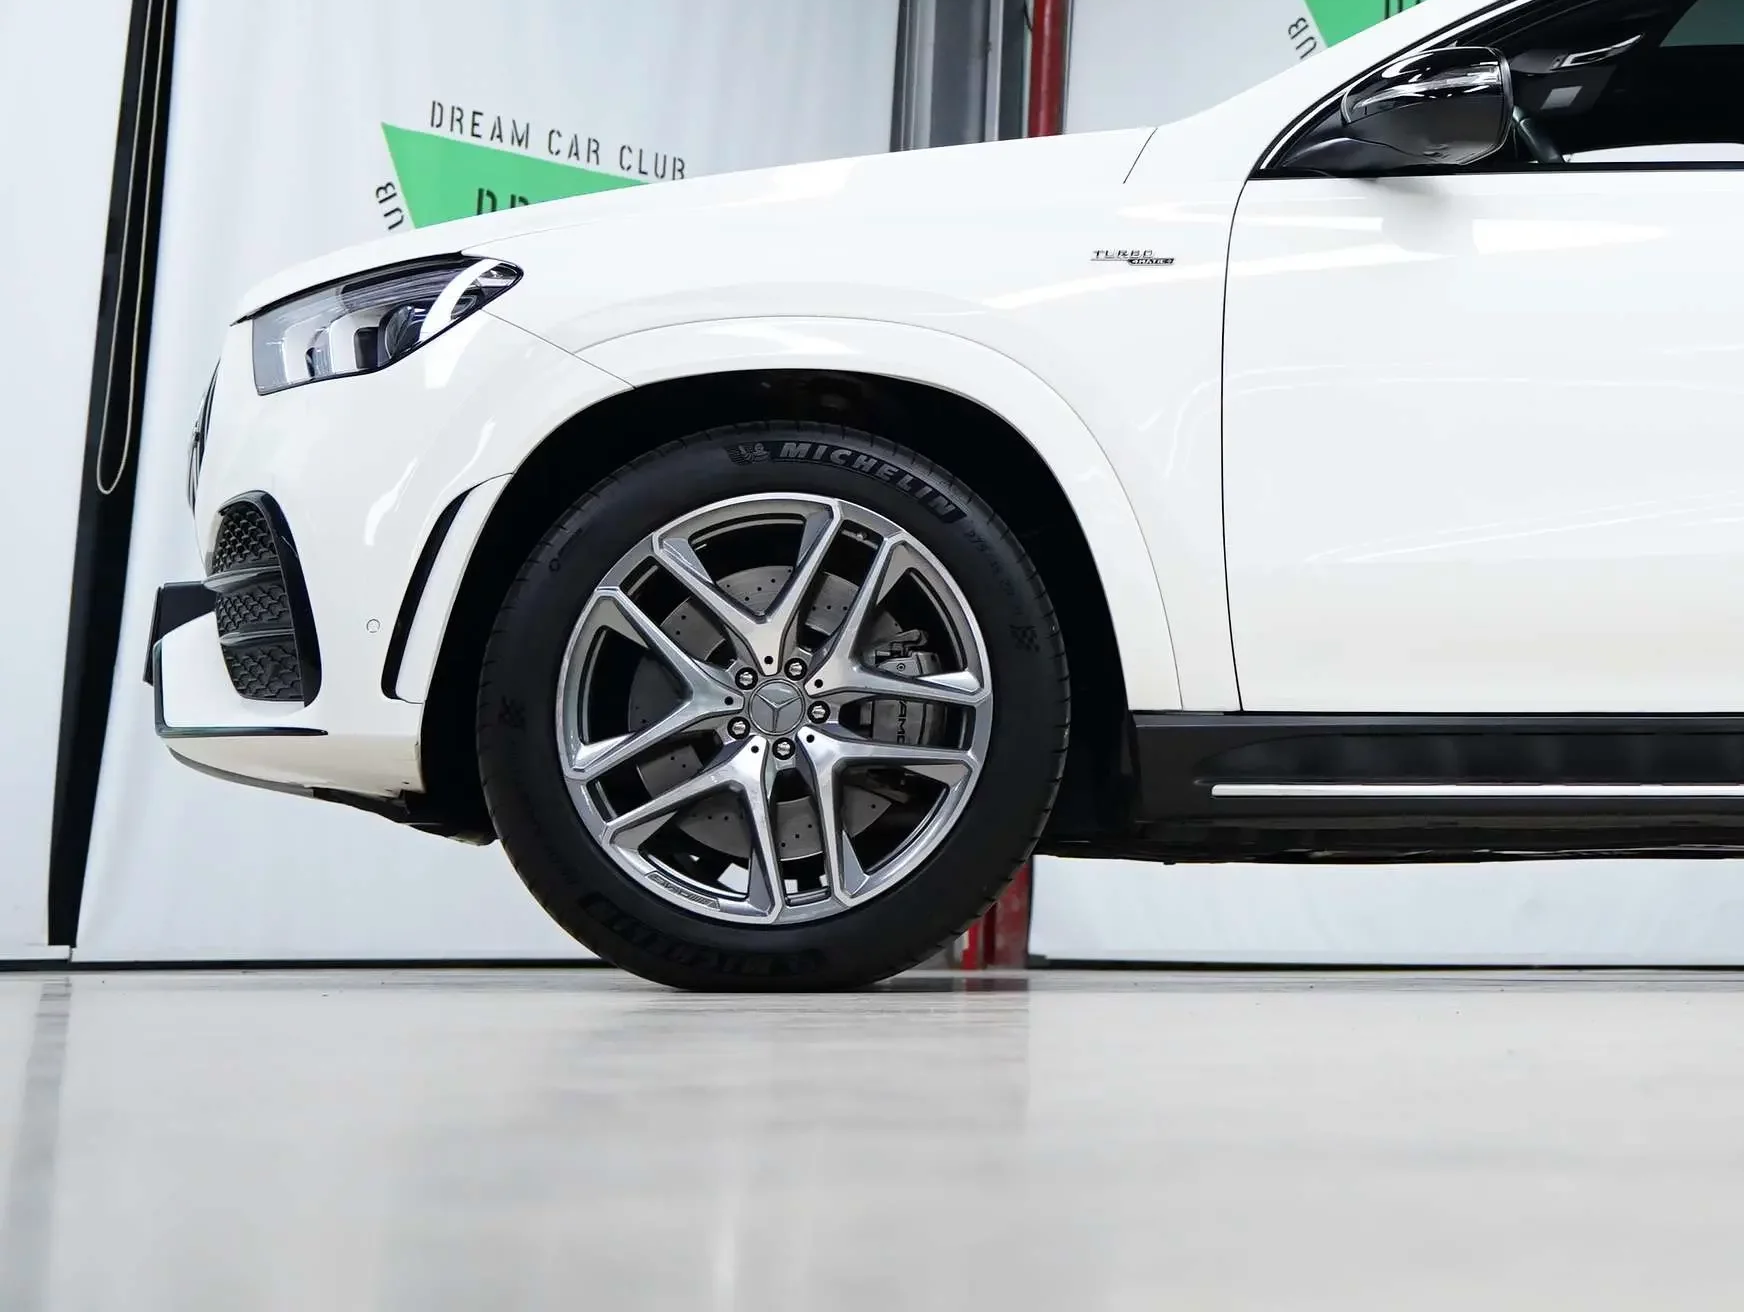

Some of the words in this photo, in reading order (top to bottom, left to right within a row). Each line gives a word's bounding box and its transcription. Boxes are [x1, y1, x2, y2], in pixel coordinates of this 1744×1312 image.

[429, 99, 531, 150] DREAM
[547, 128, 601, 166] CAR
[618, 144, 686, 180] CLUB
[779, 441, 957, 517] MICHELIN
